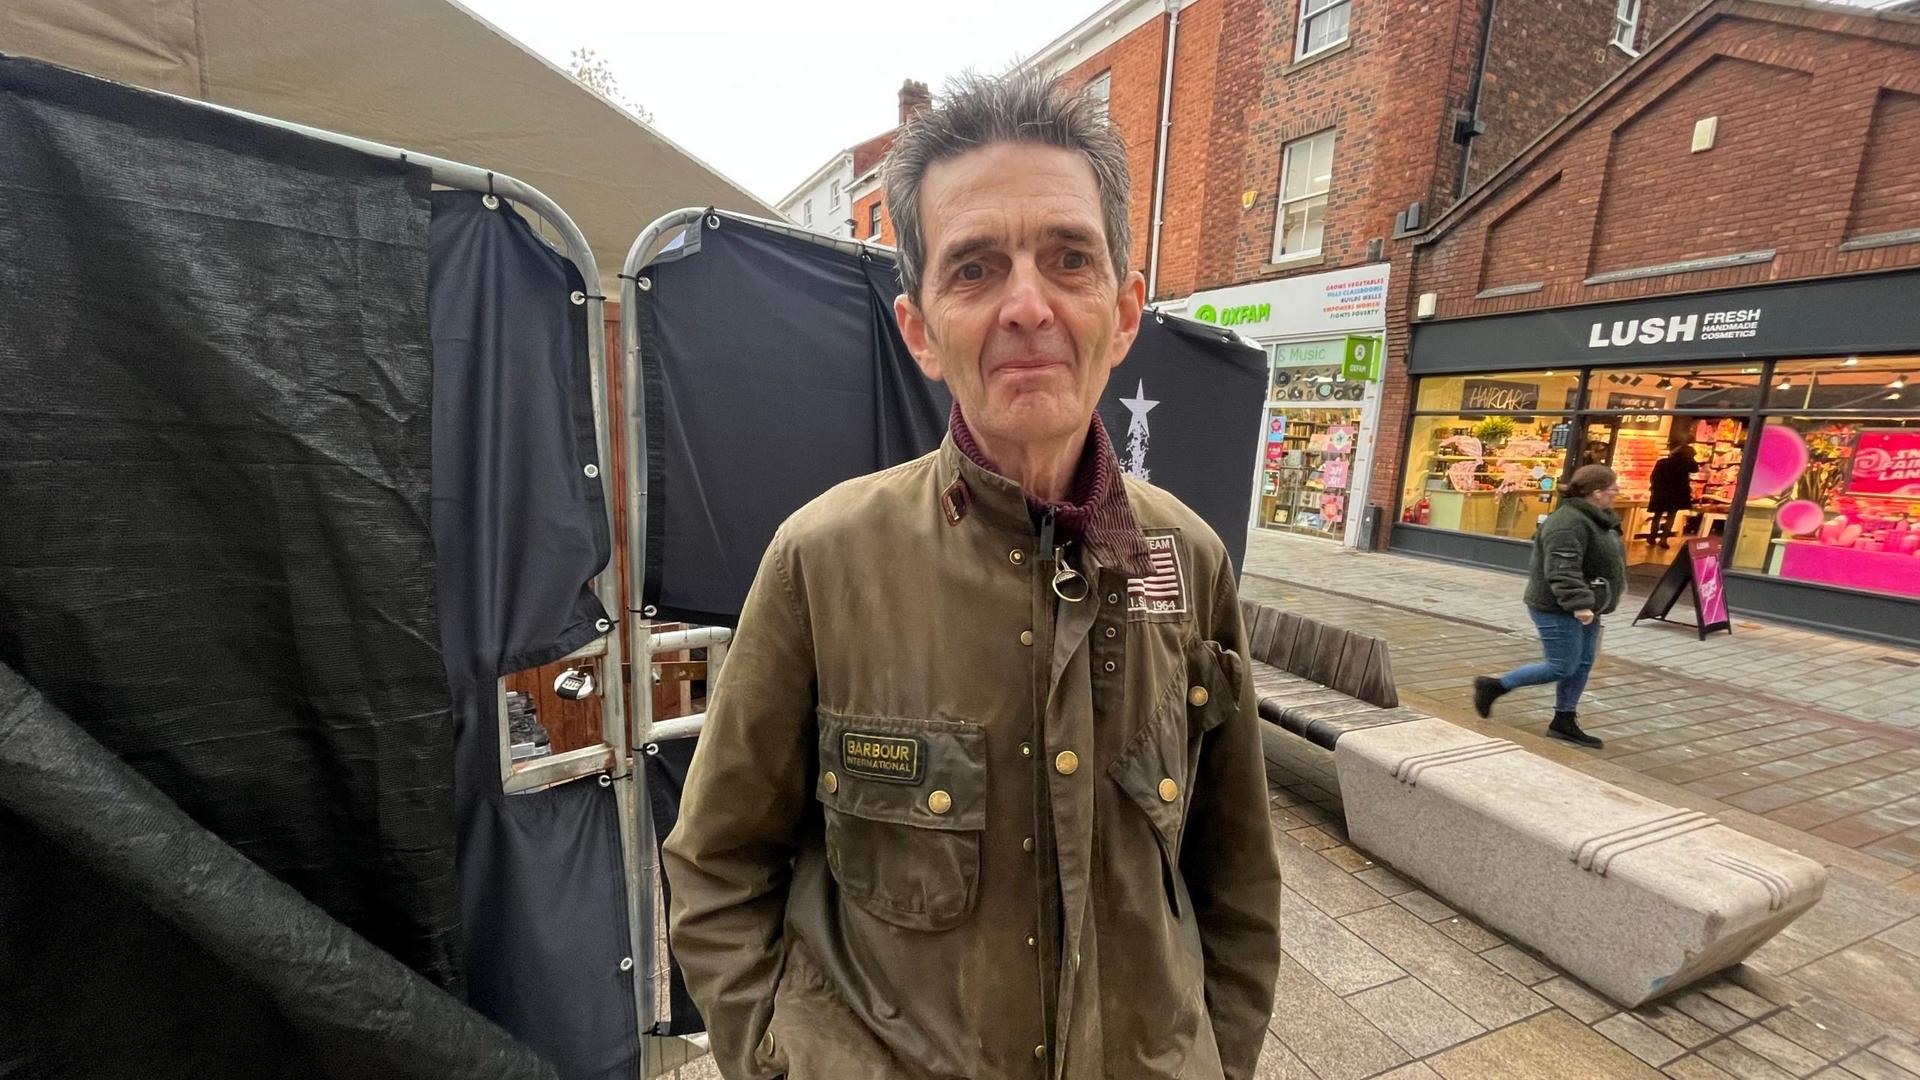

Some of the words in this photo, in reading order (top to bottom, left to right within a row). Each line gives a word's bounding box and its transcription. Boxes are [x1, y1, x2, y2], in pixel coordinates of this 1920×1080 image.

[1348, 278, 1384, 287] VEGETABLES
[1343, 286, 1383, 296] CLASSROOMS
[1362, 293, 1382, 301] WELLS
[1356, 301, 1380, 309] WOMEN
[1221, 302, 1271, 326] OXFAM
[1704, 308, 1761, 325] FRESH
[1588, 314, 1699, 348] LUSH
[1702, 321, 1758, 332] HANDMADE
[1701, 330, 1756, 341] COSMETICS
[1289, 347, 1326, 361] Music
[1469, 384, 1535, 411] HAIRCARE
[1150, 540, 1170, 549] EAM
[1152, 601, 1176, 611] 1964
[847, 740, 910, 761] BARBOUR
[847, 756, 911, 772] INTERNATIONAL
